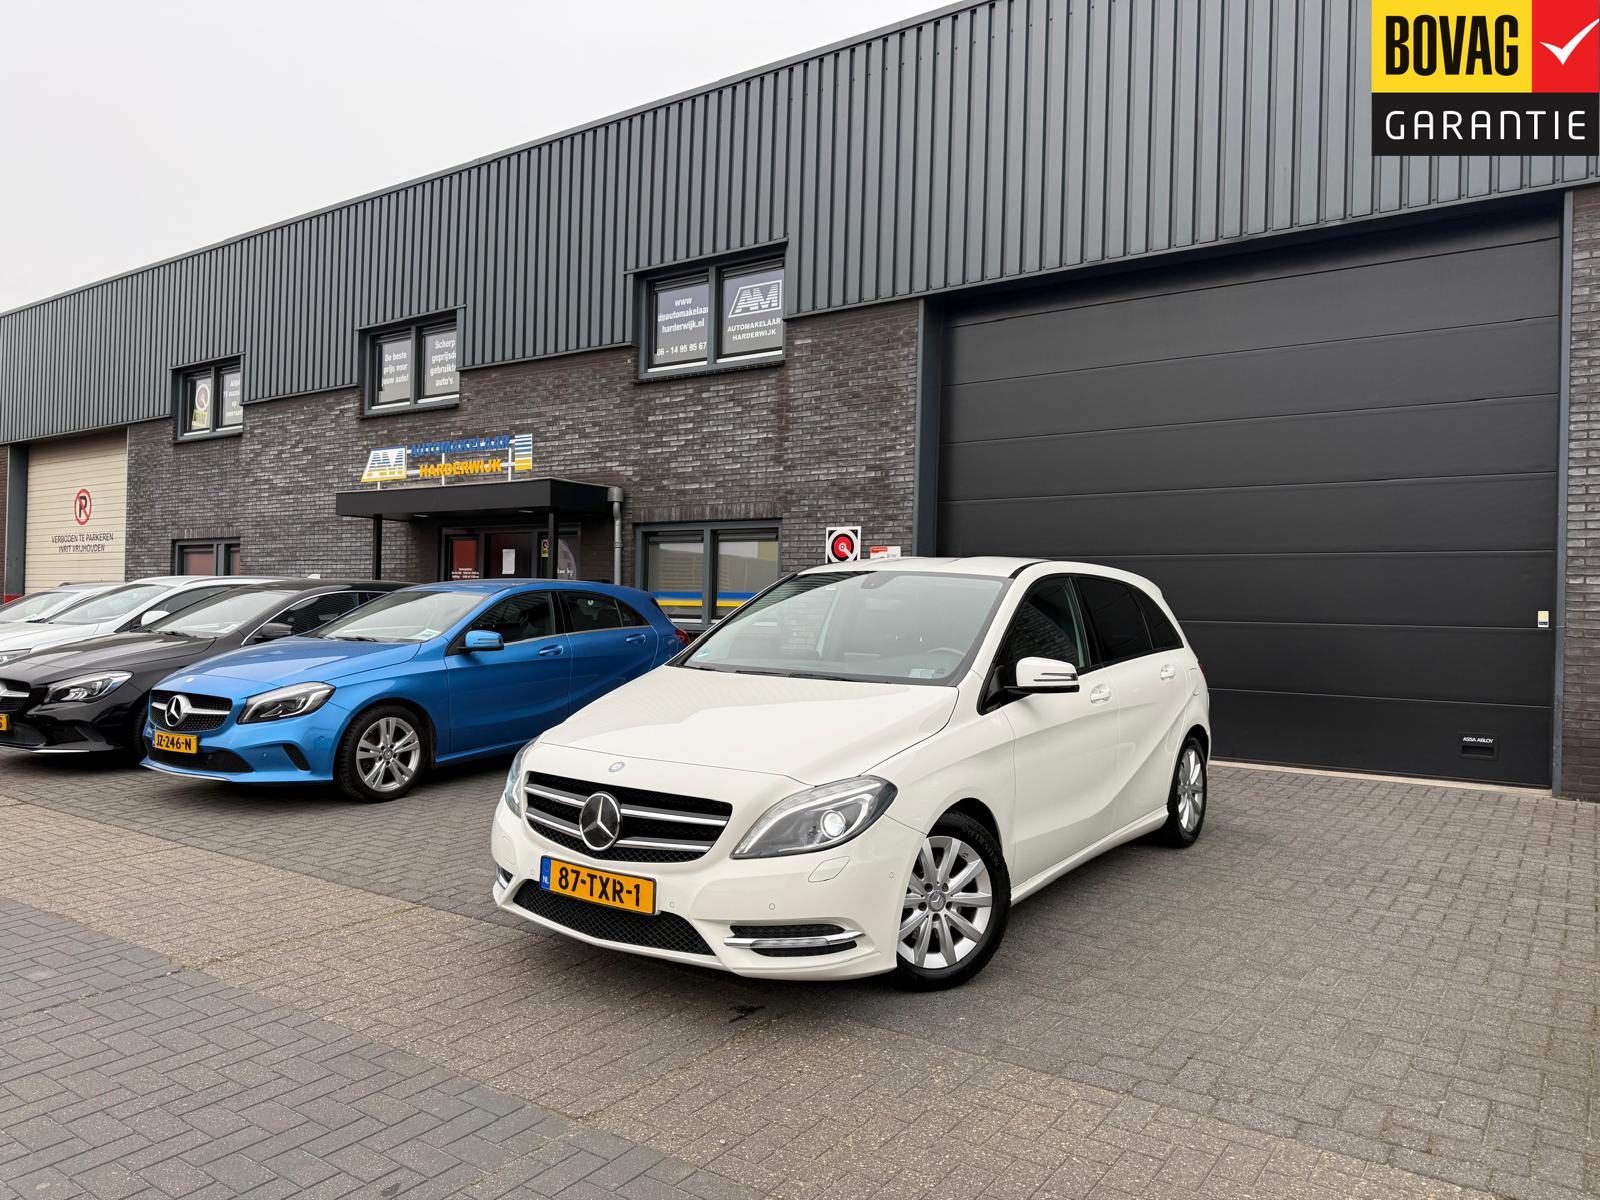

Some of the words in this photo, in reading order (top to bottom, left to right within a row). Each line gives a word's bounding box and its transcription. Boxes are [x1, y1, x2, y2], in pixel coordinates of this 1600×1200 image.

[674, 297, 693, 307] www
[661, 318, 705, 334] harderwijk.nl
[727, 317, 781, 332] AUTOMAKELAAR
[732, 328, 777, 341] HARDERWIJK
[434, 339, 456, 350] Scherp
[656, 348, 665, 357] 06
[670, 345, 678, 354] 14
[679, 344, 688, 353] 95
[689, 342, 698, 351] 95
[698, 341, 707, 350] 67
[435, 376, 454, 387] auto's
[410, 435, 511, 457] AUTOMAKELAAR
[419, 458, 503, 477] HARDERWIJK
[51, 534, 78, 544] VERBODEN
[79, 533, 85, 542] TE
[86, 532, 114, 542] PARKEREN
[156, 734, 192, 751] JZ-246-N
[558, 866, 641, 907] 87-TXR-1
